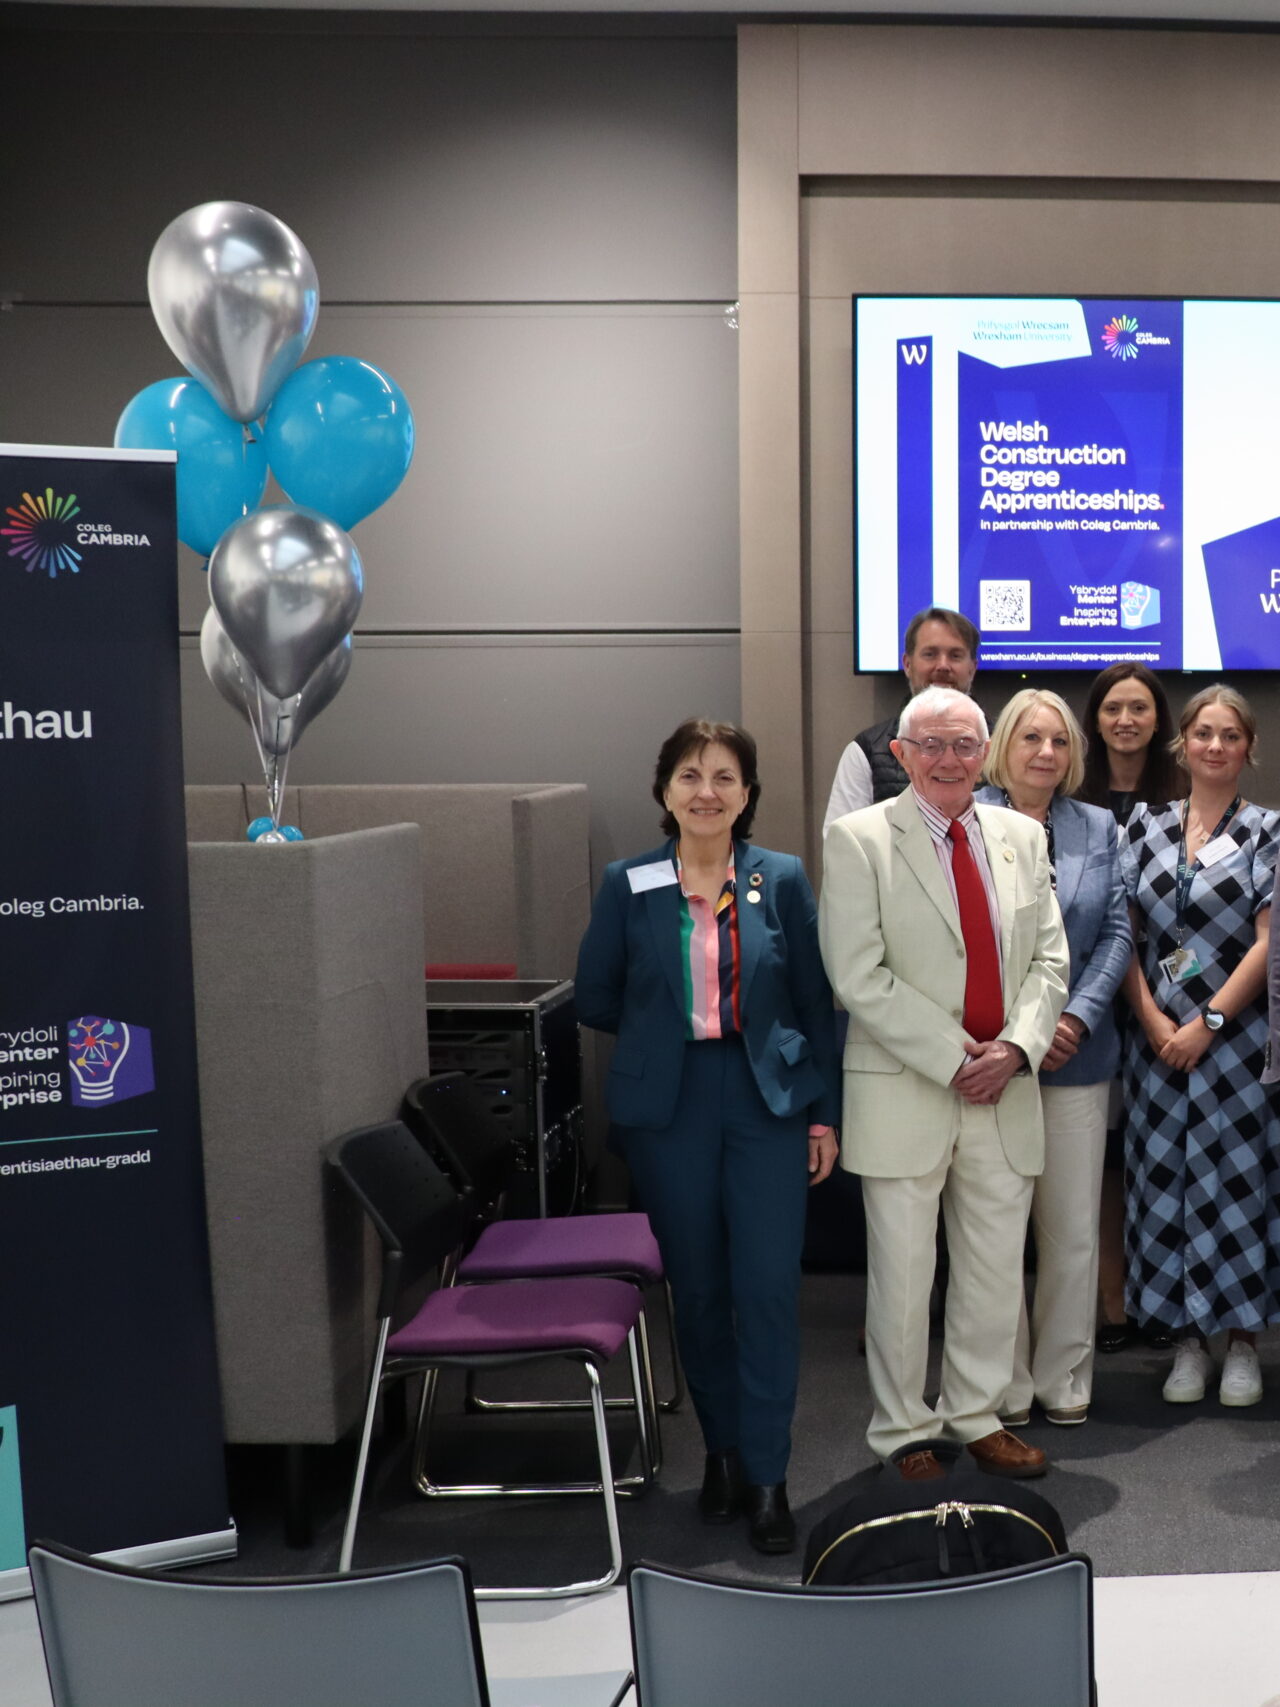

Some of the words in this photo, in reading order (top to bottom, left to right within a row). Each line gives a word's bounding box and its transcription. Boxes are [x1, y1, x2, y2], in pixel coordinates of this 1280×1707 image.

[1021, 320, 1070, 330] Wrecsam
[1135, 337, 1171, 345] CAMBRIA
[902, 345, 927, 365] W
[980, 421, 1048, 441] Welsh
[980, 444, 1125, 464] Construction
[981, 467, 1060, 492] Degree
[979, 489, 1165, 514] Apprenticeships.
[77, 524, 111, 532] COLEG
[992, 520, 1054, 532] partnership
[1055, 520, 1079, 530] with
[1080, 520, 1111, 532] Coleg
[1112, 520, 1160, 530] Cambria.
[77, 533, 150, 546] CAMBRIA
[1077, 595, 1118, 604] Menter
[1073, 606, 1118, 618] Inspiring
[1059, 615, 1118, 628] Enterprise
[0, 702, 92, 739] hau
[50, 894, 144, 913] Cambria.
[0, 1087, 62, 1109] prise
